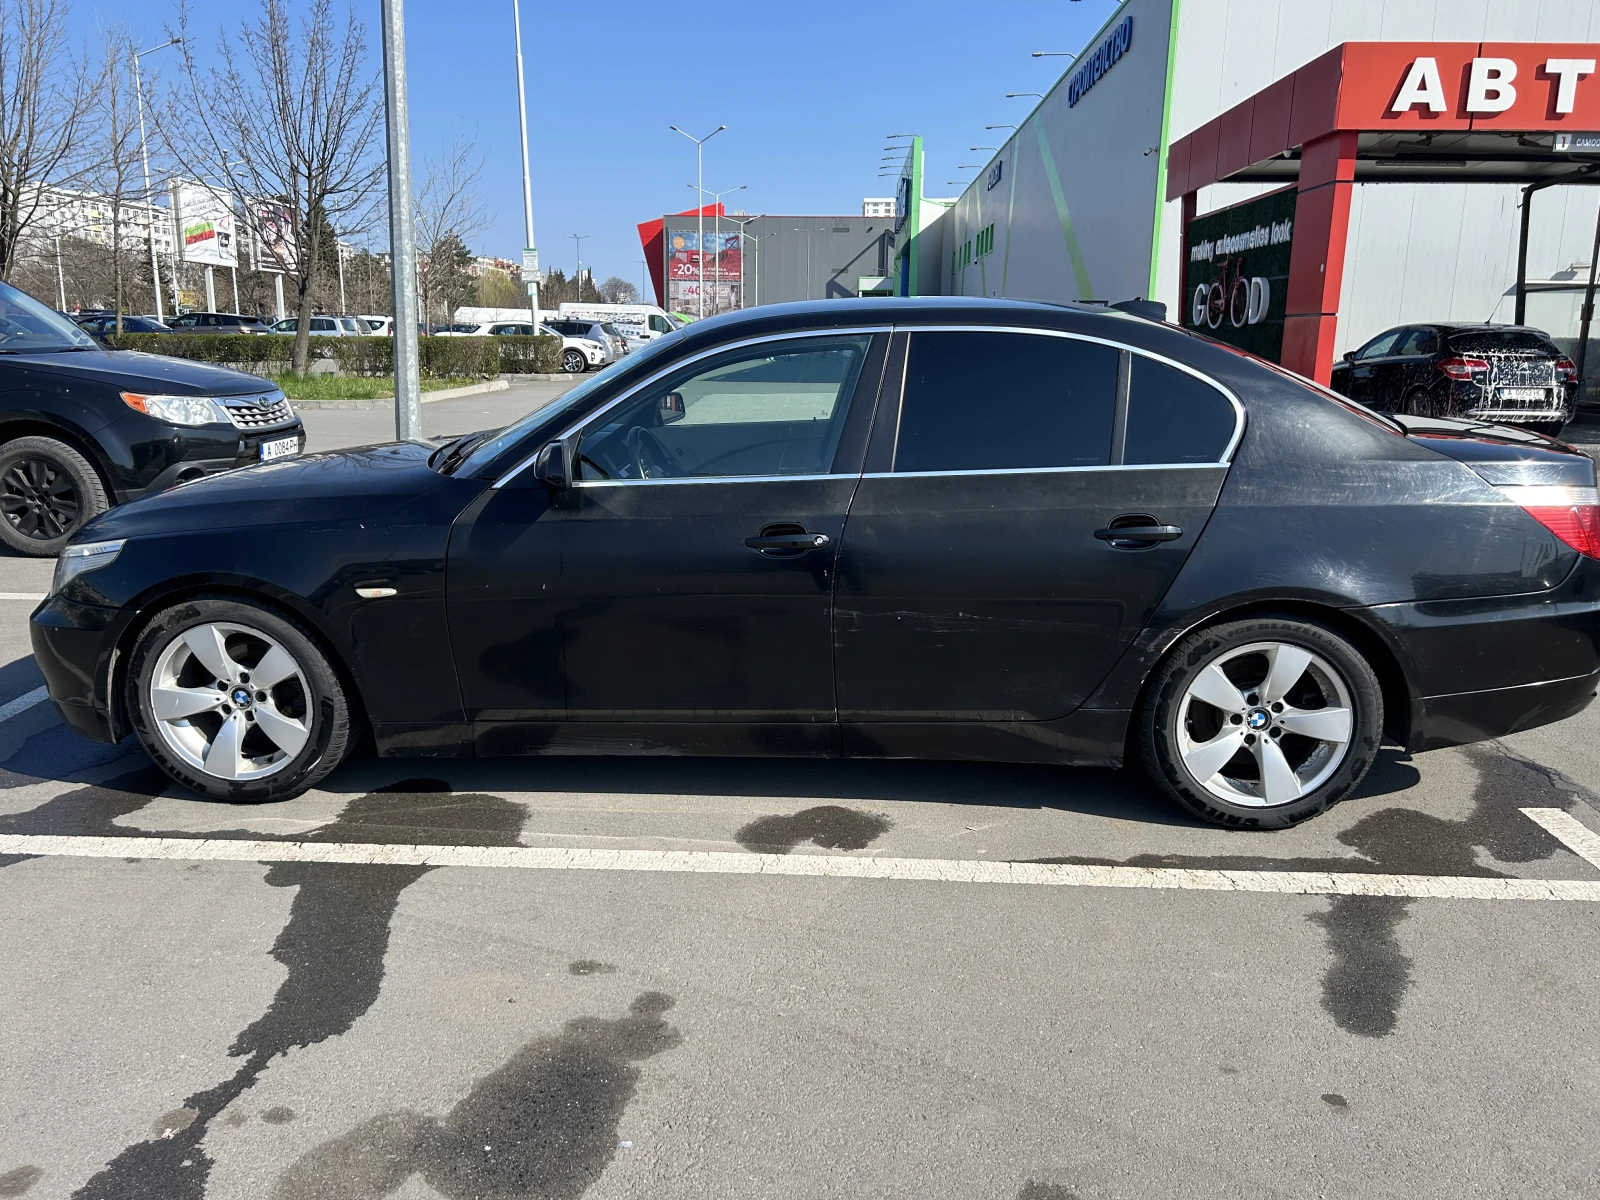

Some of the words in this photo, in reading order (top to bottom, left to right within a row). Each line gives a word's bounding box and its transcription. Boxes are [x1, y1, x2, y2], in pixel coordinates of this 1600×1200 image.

[1067, 15, 1133, 108] СТРОИТЕЛСТВО
[1391, 57, 1596, 113] АВТ
[1561, 135, 1567, 148] 1
[1190, 239, 1214, 263] making
[1270, 217, 1292, 245] look
[674, 264, 699, 275] -20%
[267, 445, 272, 458] A
[1227, 625, 1256, 638] ICE
[1257, 623, 1323, 640] BLAZER
[1178, 787, 1260, 827] SAILUN
